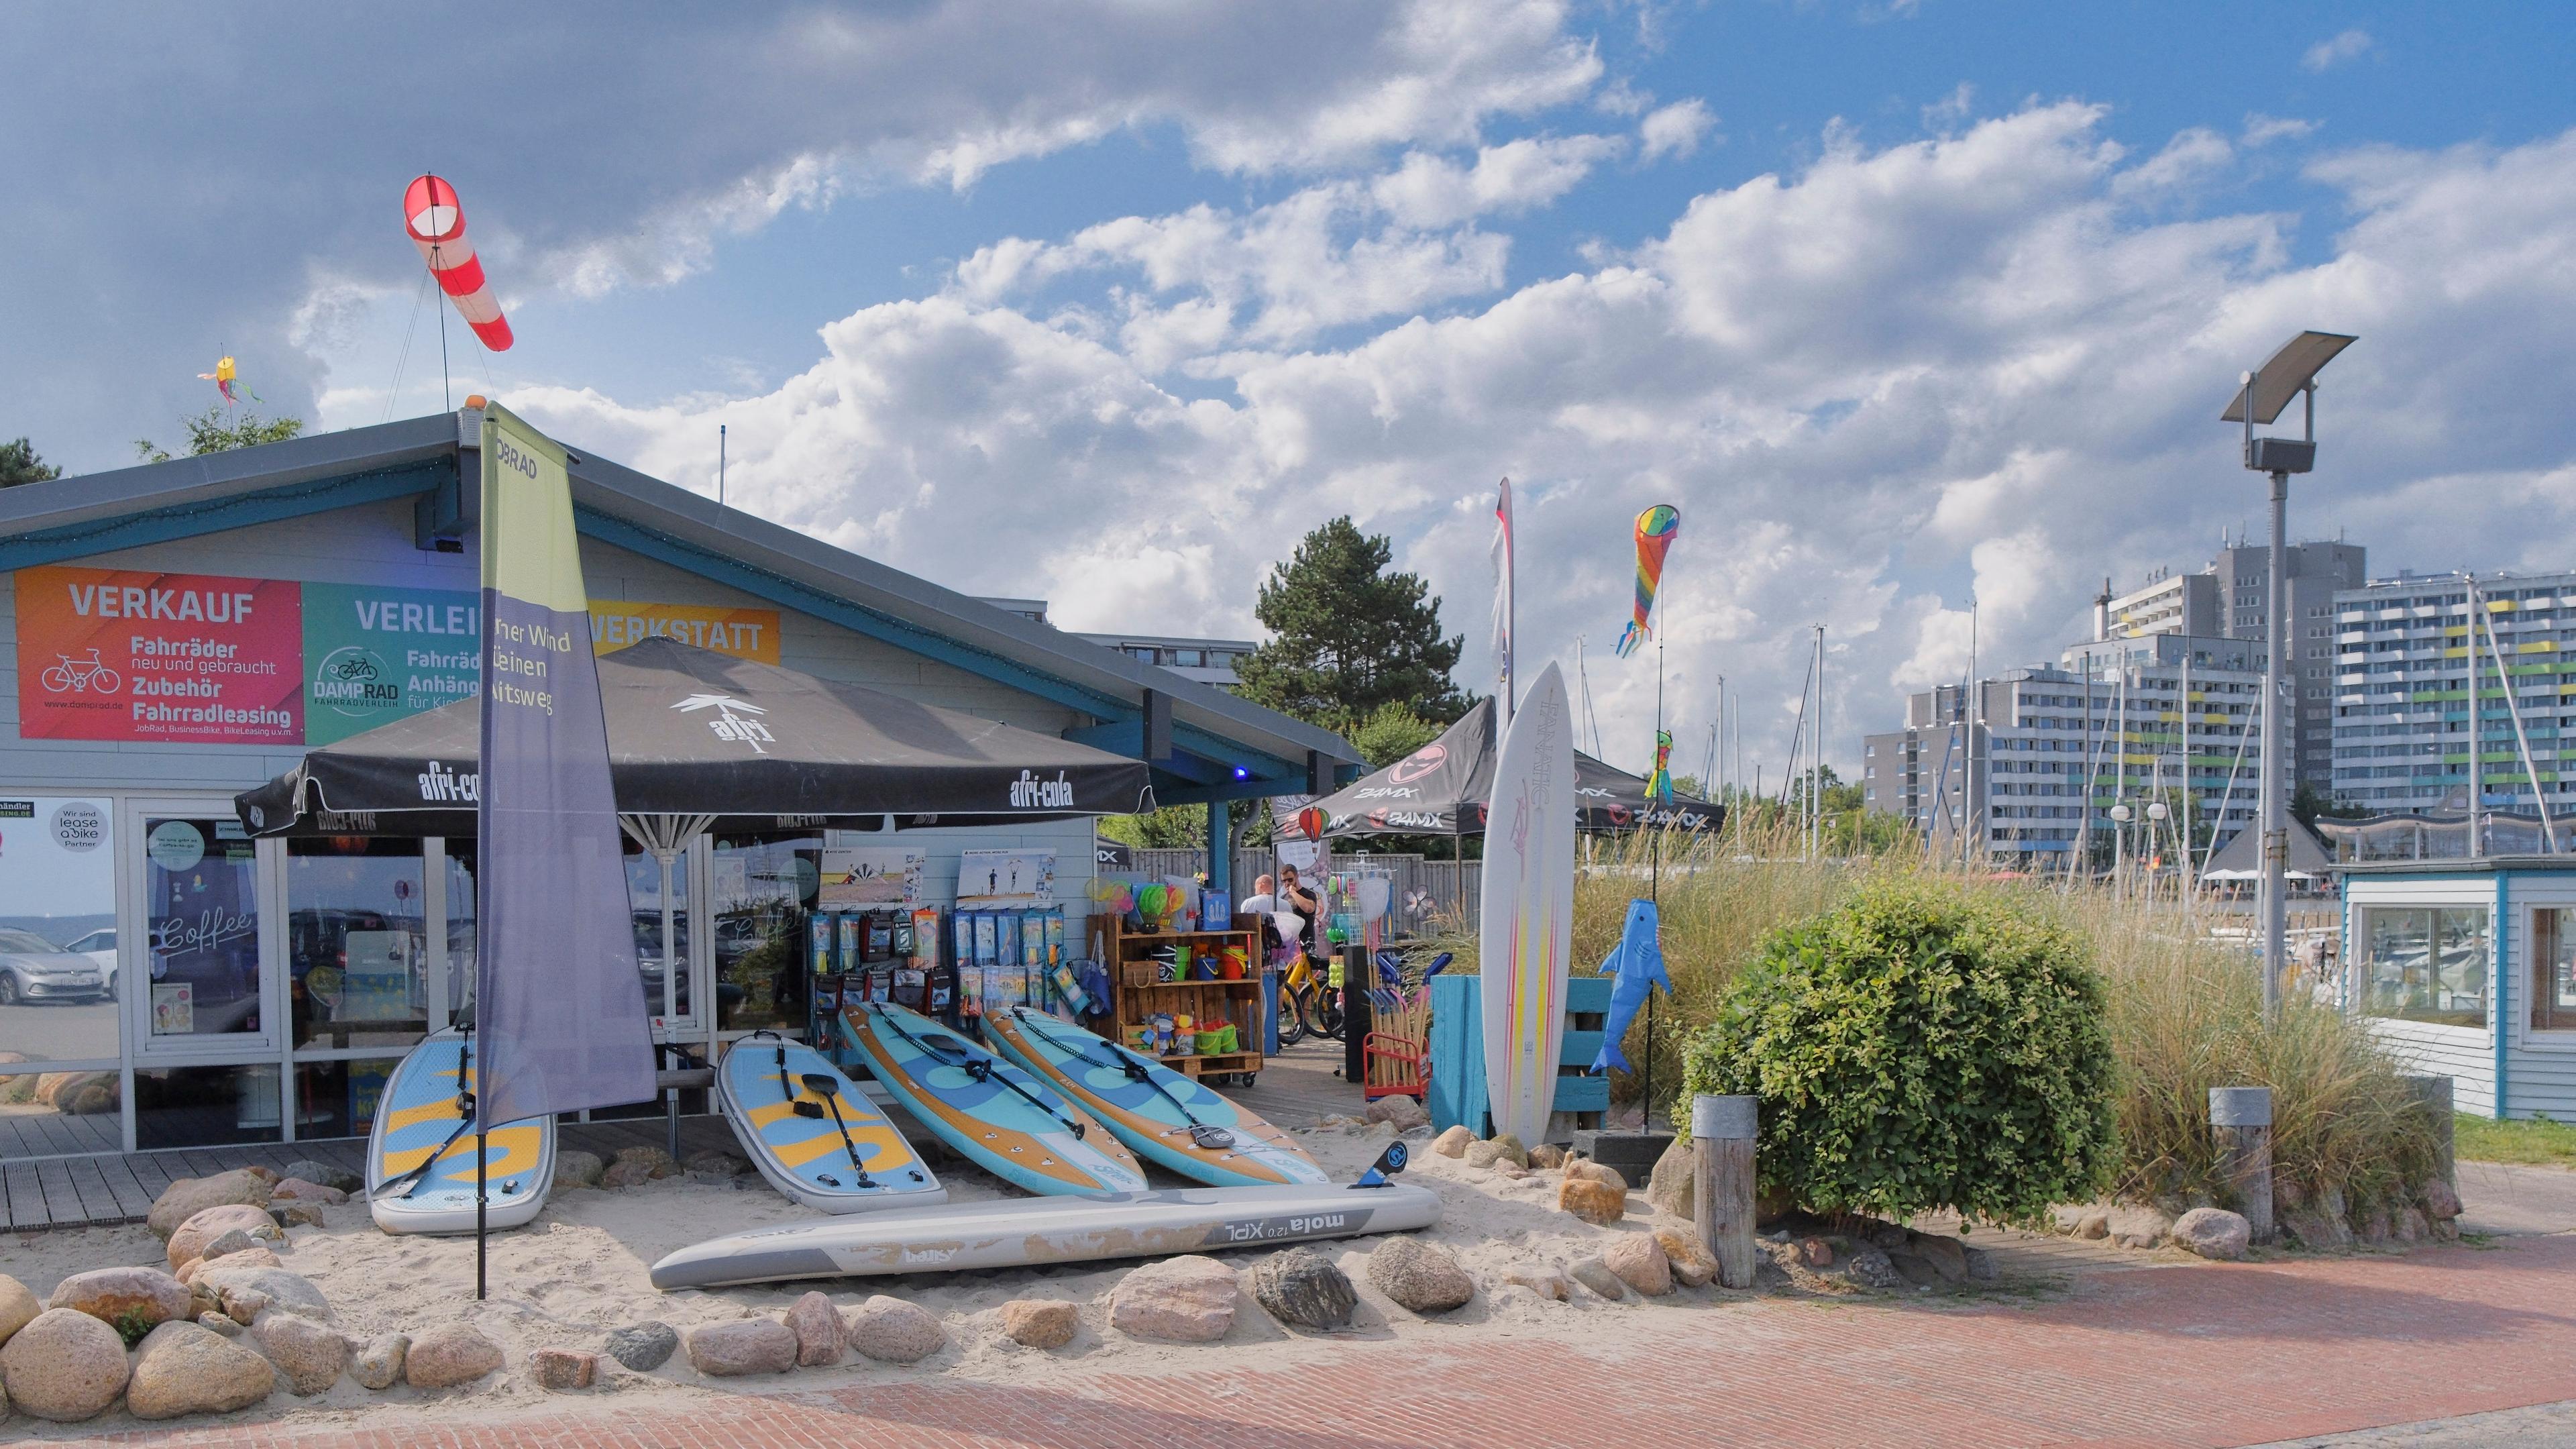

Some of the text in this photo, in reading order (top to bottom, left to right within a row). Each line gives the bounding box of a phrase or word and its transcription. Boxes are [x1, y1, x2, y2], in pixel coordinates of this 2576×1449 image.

[496, 438, 537, 479] OBRAD
[68, 584, 253, 623] VERKAUF
[355, 600, 476, 635] VERLEI
[131, 636, 237, 658] Fahrräder
[528, 624, 571, 652] Wind
[131, 657, 276, 675] neu und gebraucht
[407, 649, 480, 669] Fahrräd
[499, 651, 547, 678] einen
[132, 676, 222, 697] Zubehör
[314, 682, 398, 700] DAMPRAD
[407, 675, 480, 696] Anhäng
[315, 698, 398, 708] FAHRRADVERLEIH
[408, 695, 429, 708] für
[492, 681, 553, 716] itsweg
[133, 702, 291, 728] Fahrradleasing
[135, 724, 166, 733] JobRad,
[169, 725, 222, 735] BusinessBike,
[224, 727, 269, 737] BikeLeasing
[1531, 701, 1560, 805] FANATIC
[418, 761, 478, 802] afri-co
[1010, 769, 1073, 807] afri-cola
[1353, 788, 1419, 799] 24MX
[60, 818, 98, 827] lease
[1389, 812, 1443, 828] 24MX
[160, 906, 252, 955] Coffee
[1225, 1222, 1264, 1241] XPL
[1290, 1214, 1344, 1234] mola
